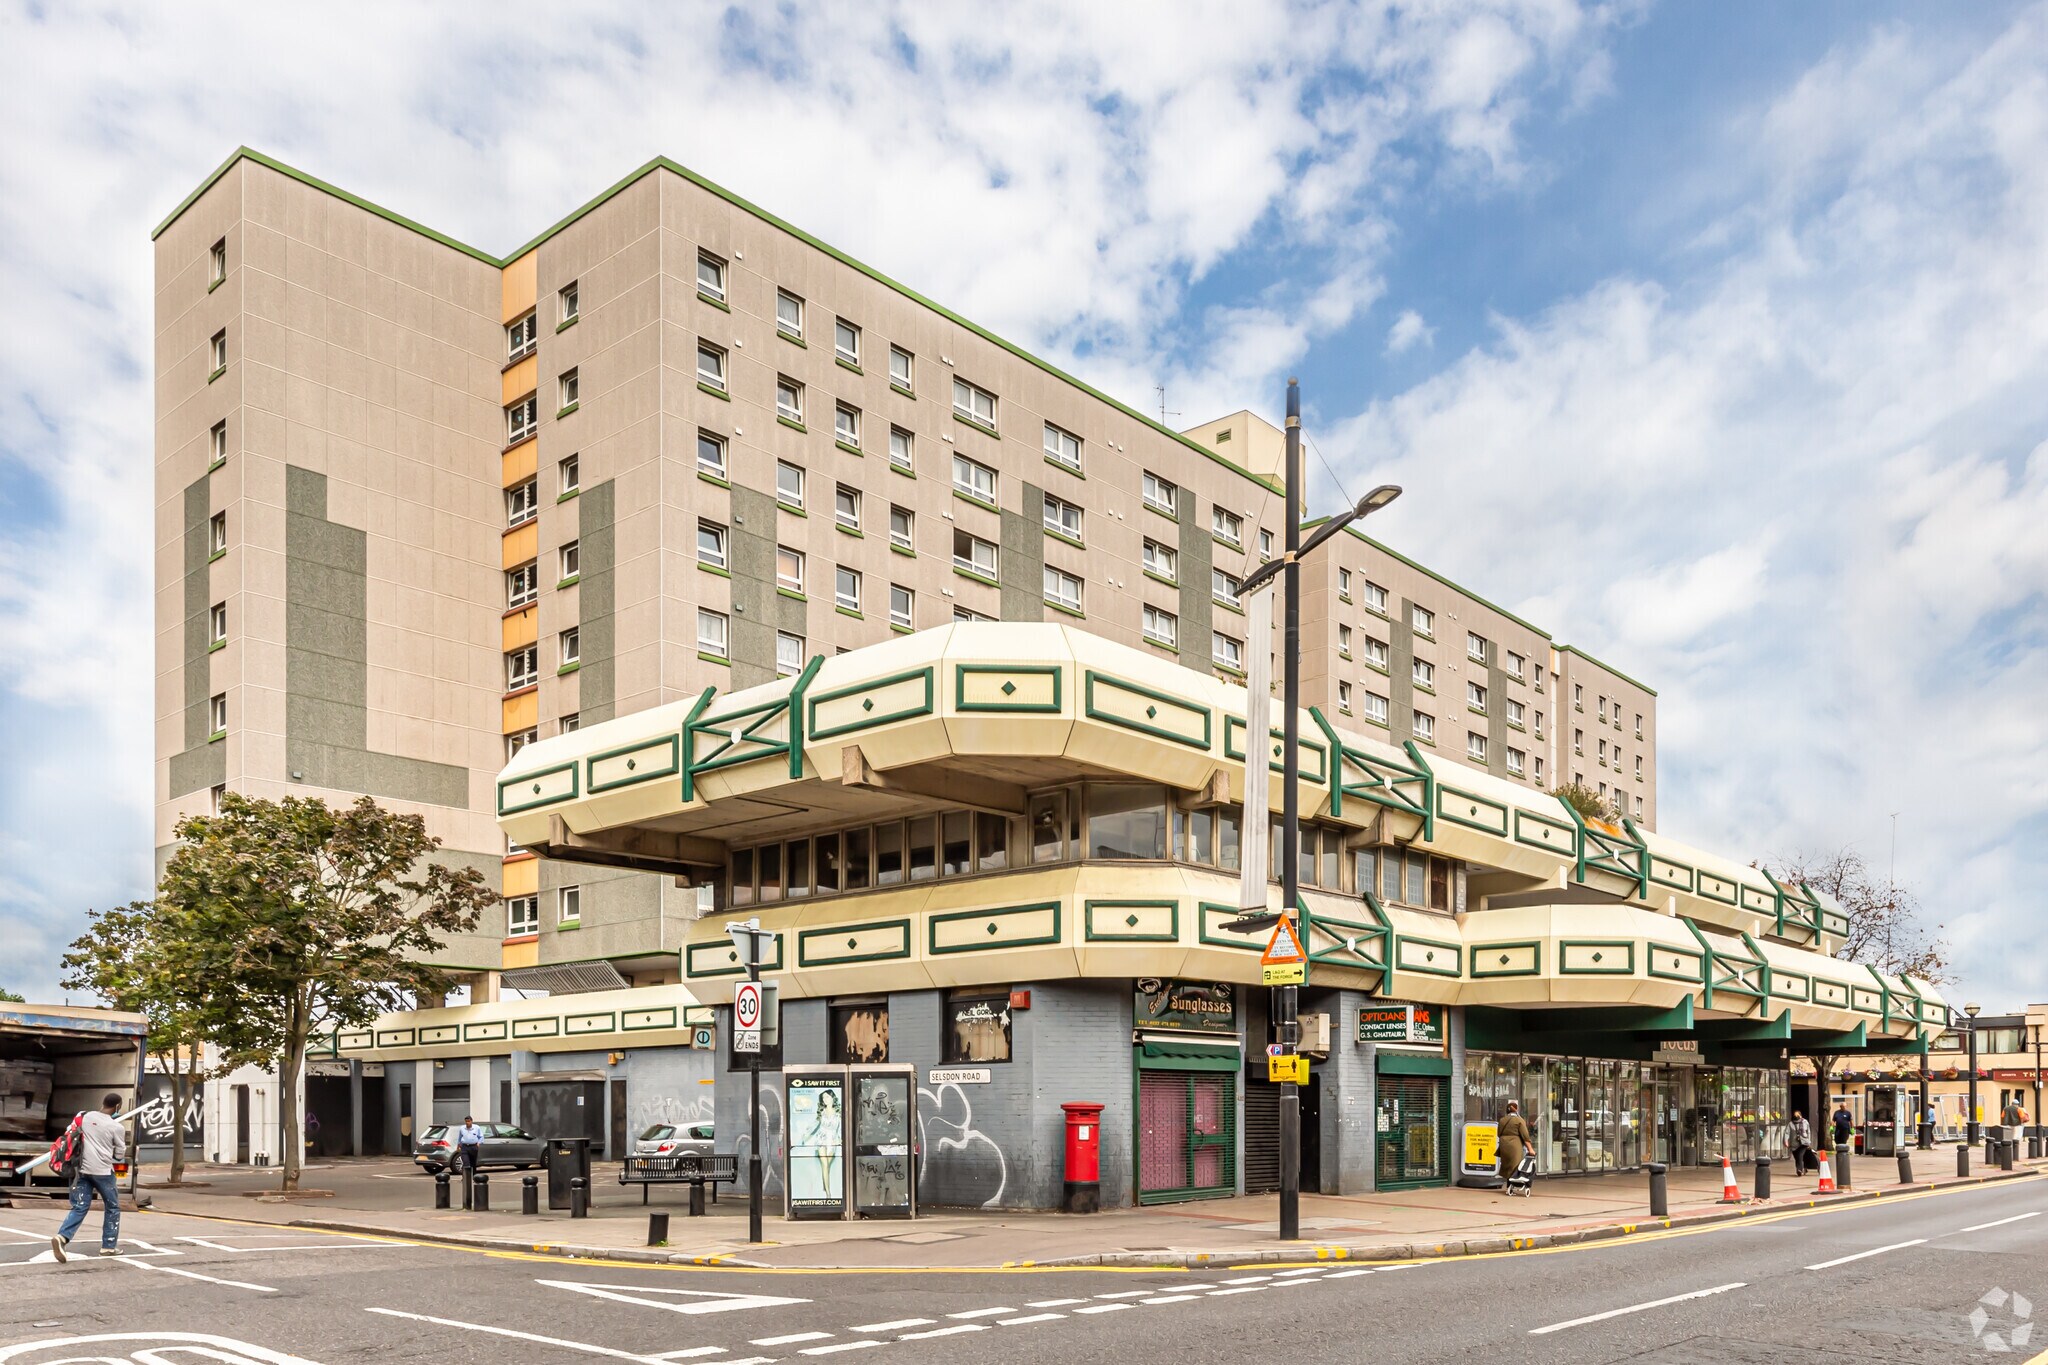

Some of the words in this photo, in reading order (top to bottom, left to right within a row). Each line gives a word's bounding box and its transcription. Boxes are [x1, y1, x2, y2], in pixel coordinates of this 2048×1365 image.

[740, 998, 756, 1015] 30
[1171, 995, 1232, 1014] Sunglasses
[1360, 1011, 1406, 1022] OPTICIANS
